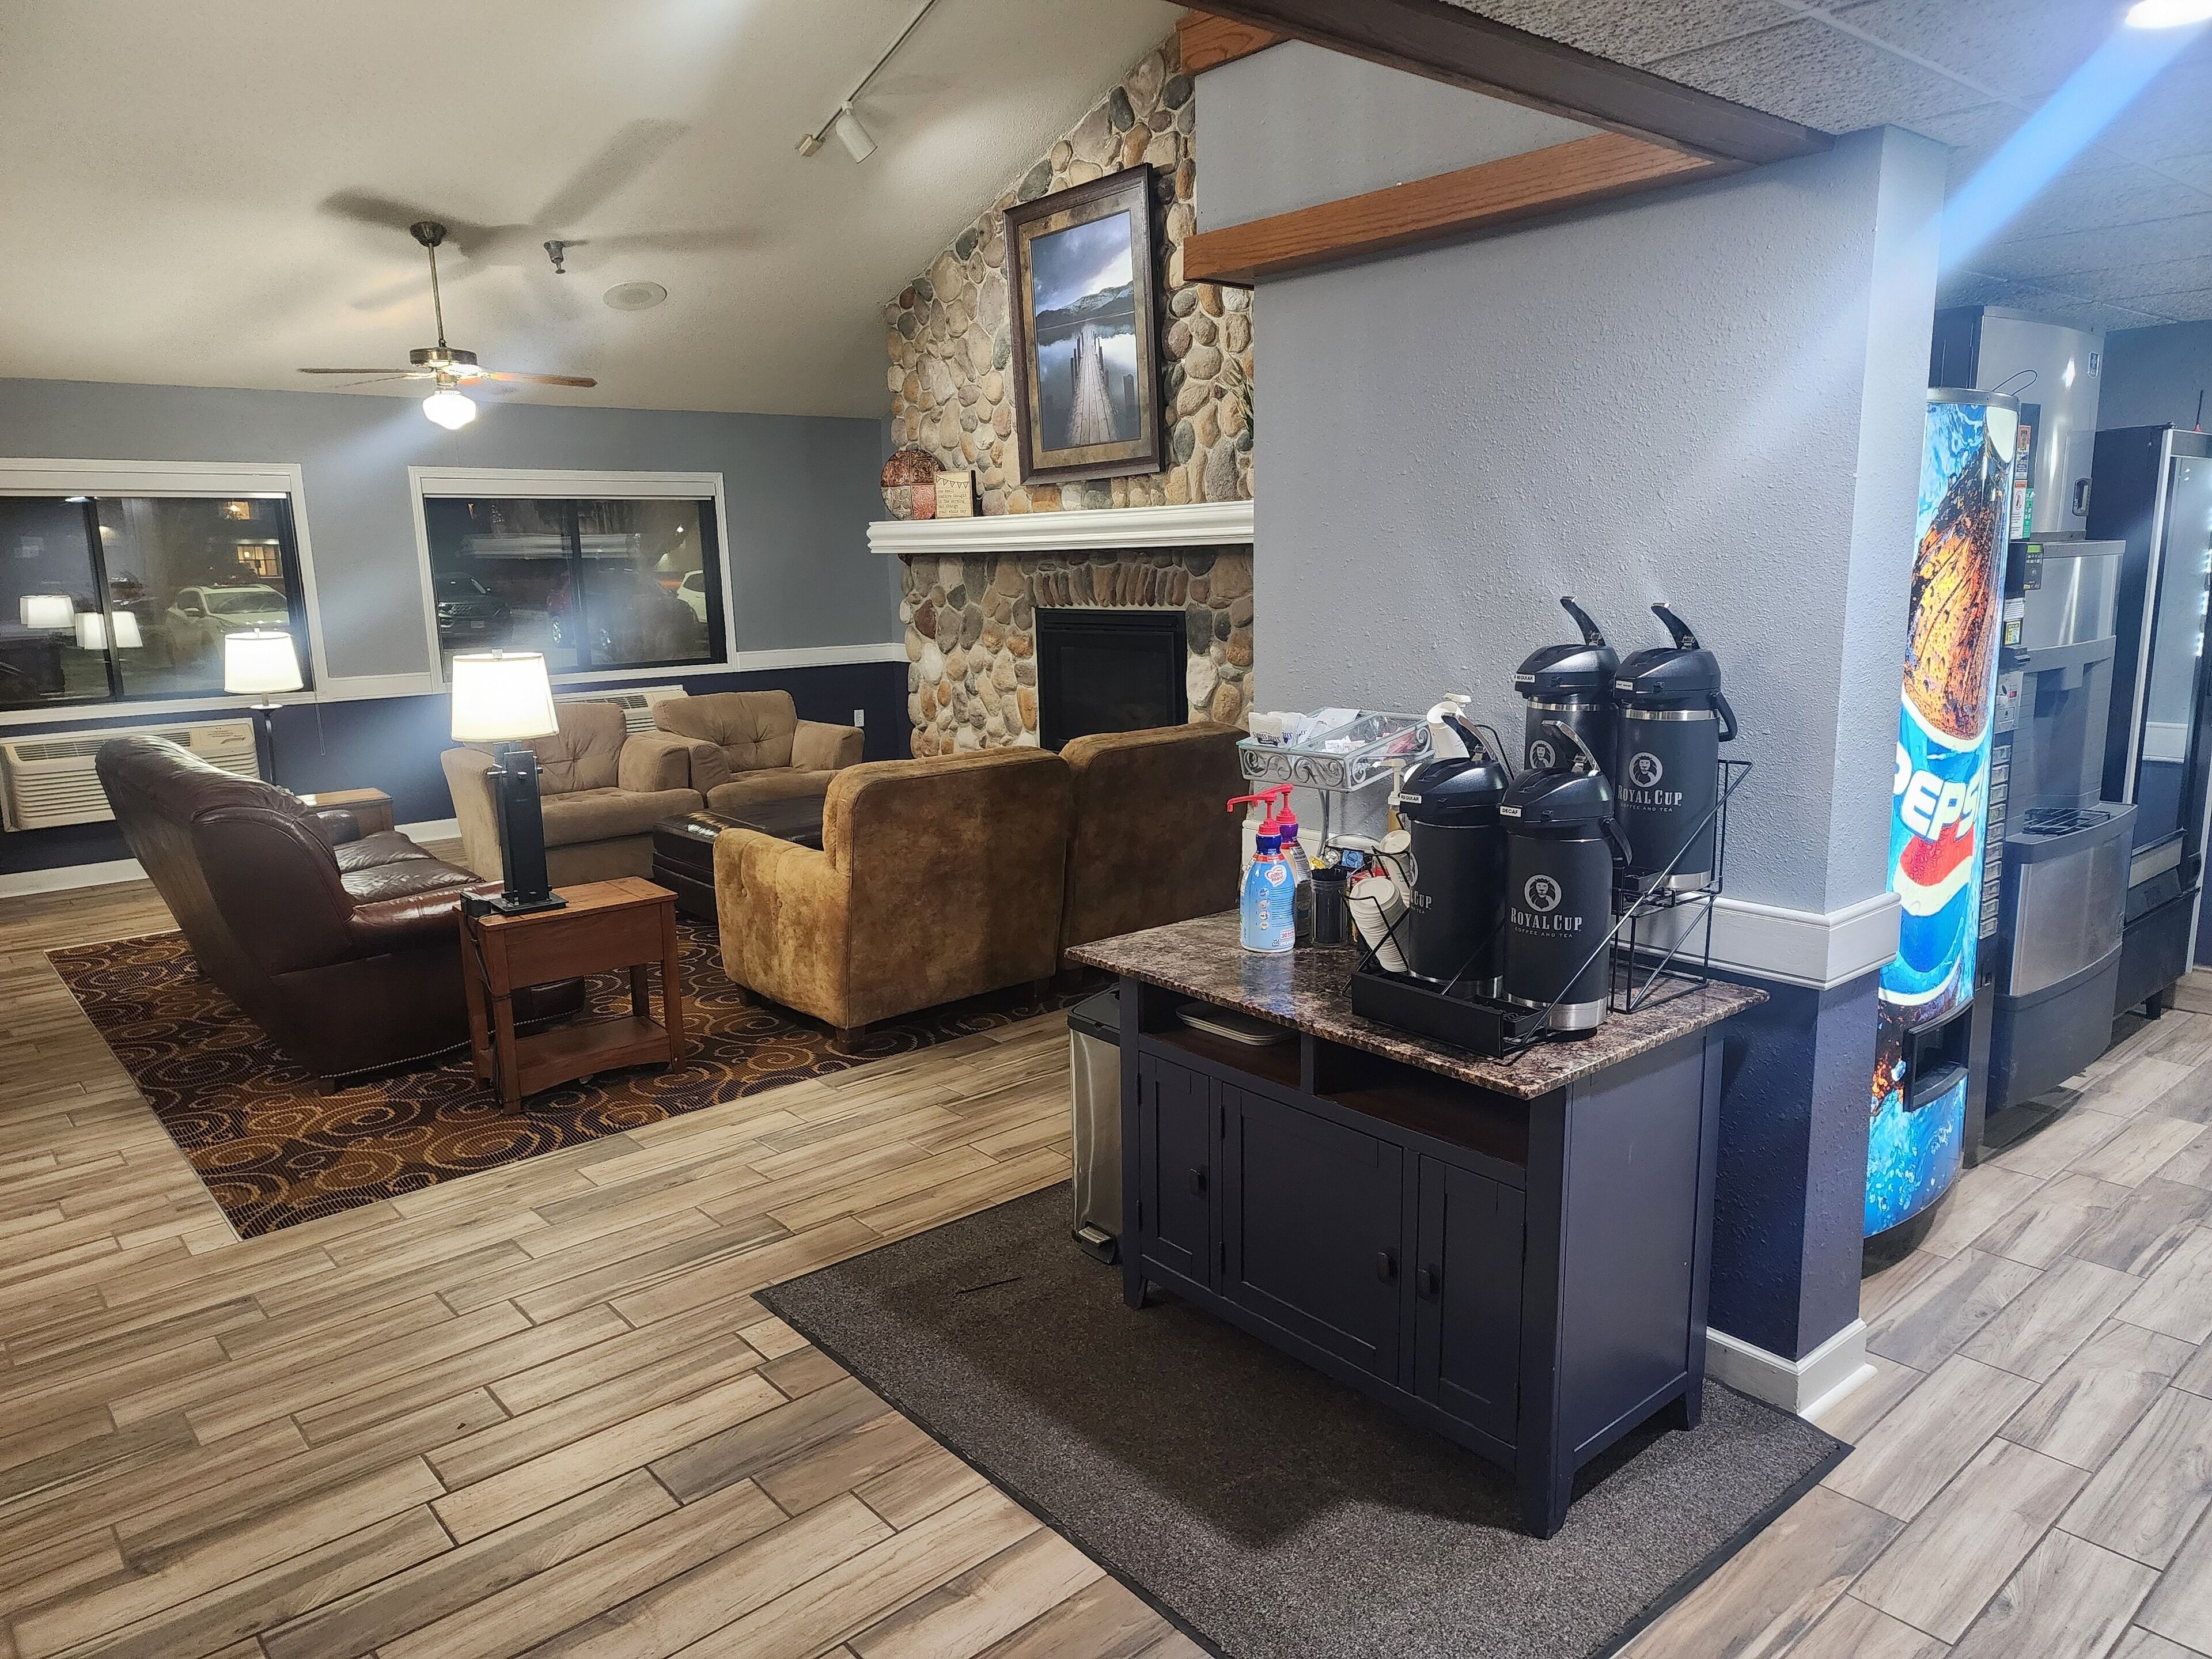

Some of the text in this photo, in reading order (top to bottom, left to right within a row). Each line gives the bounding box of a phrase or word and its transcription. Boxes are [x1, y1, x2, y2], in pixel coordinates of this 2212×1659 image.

[1618, 785, 1651, 804] ROYAL
[1511, 907, 1550, 930] ROYAL
[1514, 926, 1538, 935] COFFEE
